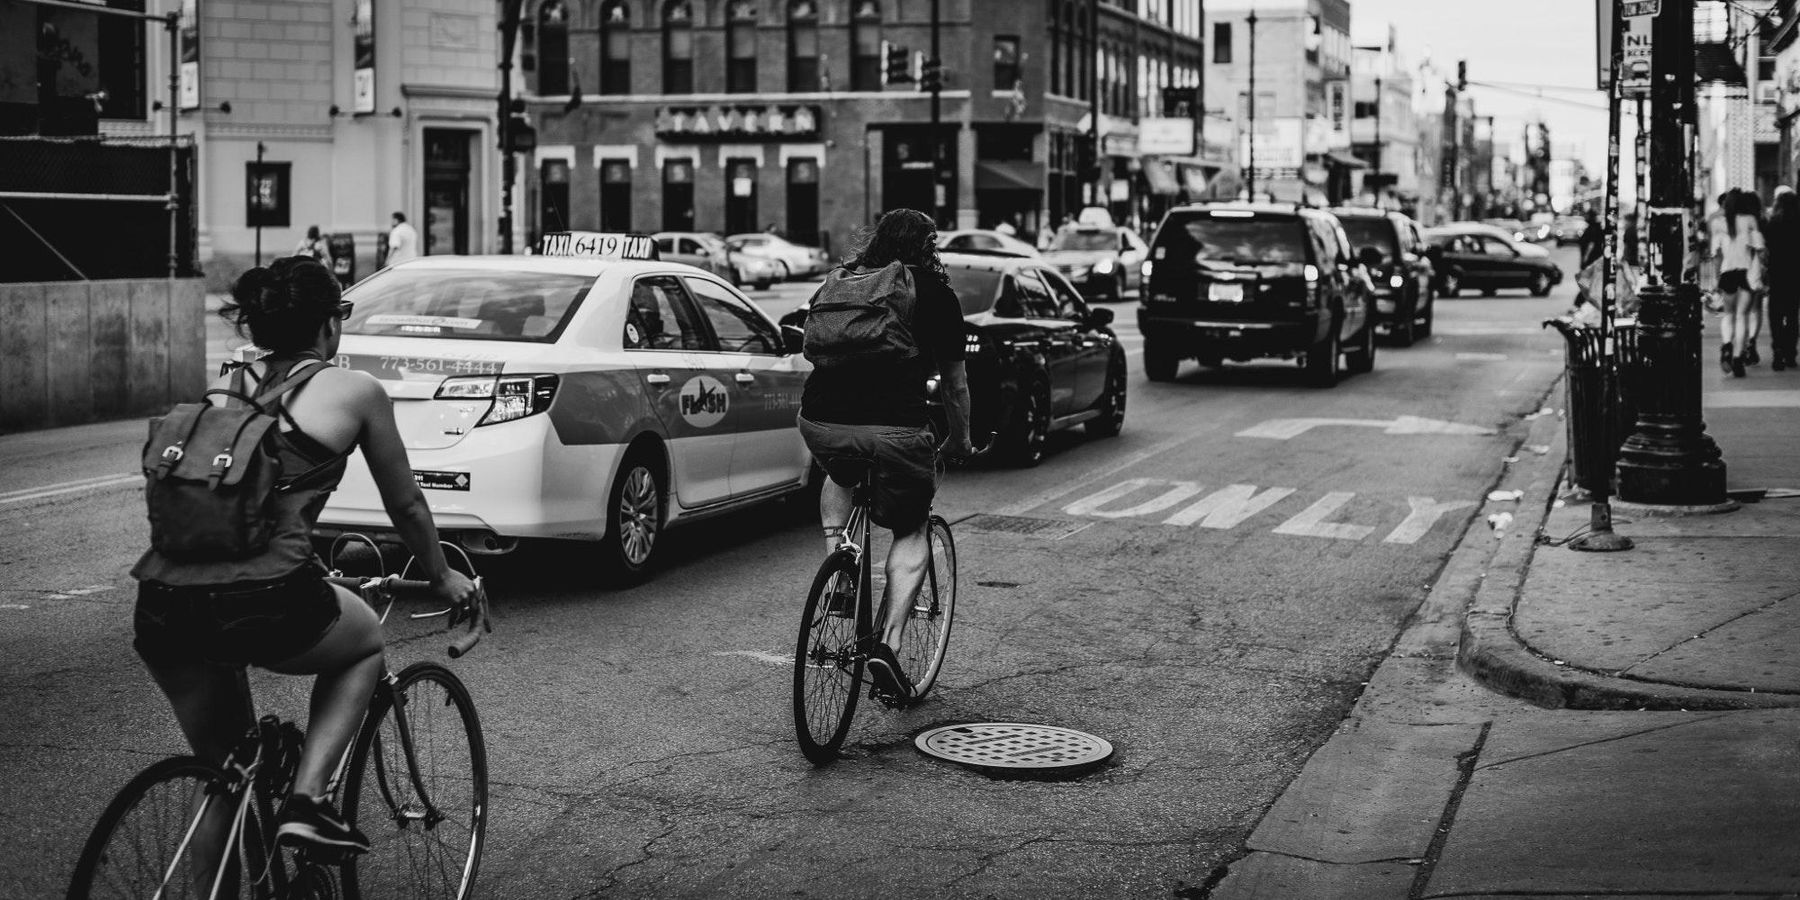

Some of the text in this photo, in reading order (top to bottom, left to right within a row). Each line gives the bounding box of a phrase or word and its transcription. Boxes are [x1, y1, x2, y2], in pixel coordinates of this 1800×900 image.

[1639, 1, 1657, 14] ZONE
[1627, 35, 1652, 46] NL
[673, 113, 815, 133] TAVERN
[543, 235, 653, 259] TAXI 6419 TAXI
[380, 356, 497, 375] 773-561-4444
[1061, 477, 1478, 544] ONLY
